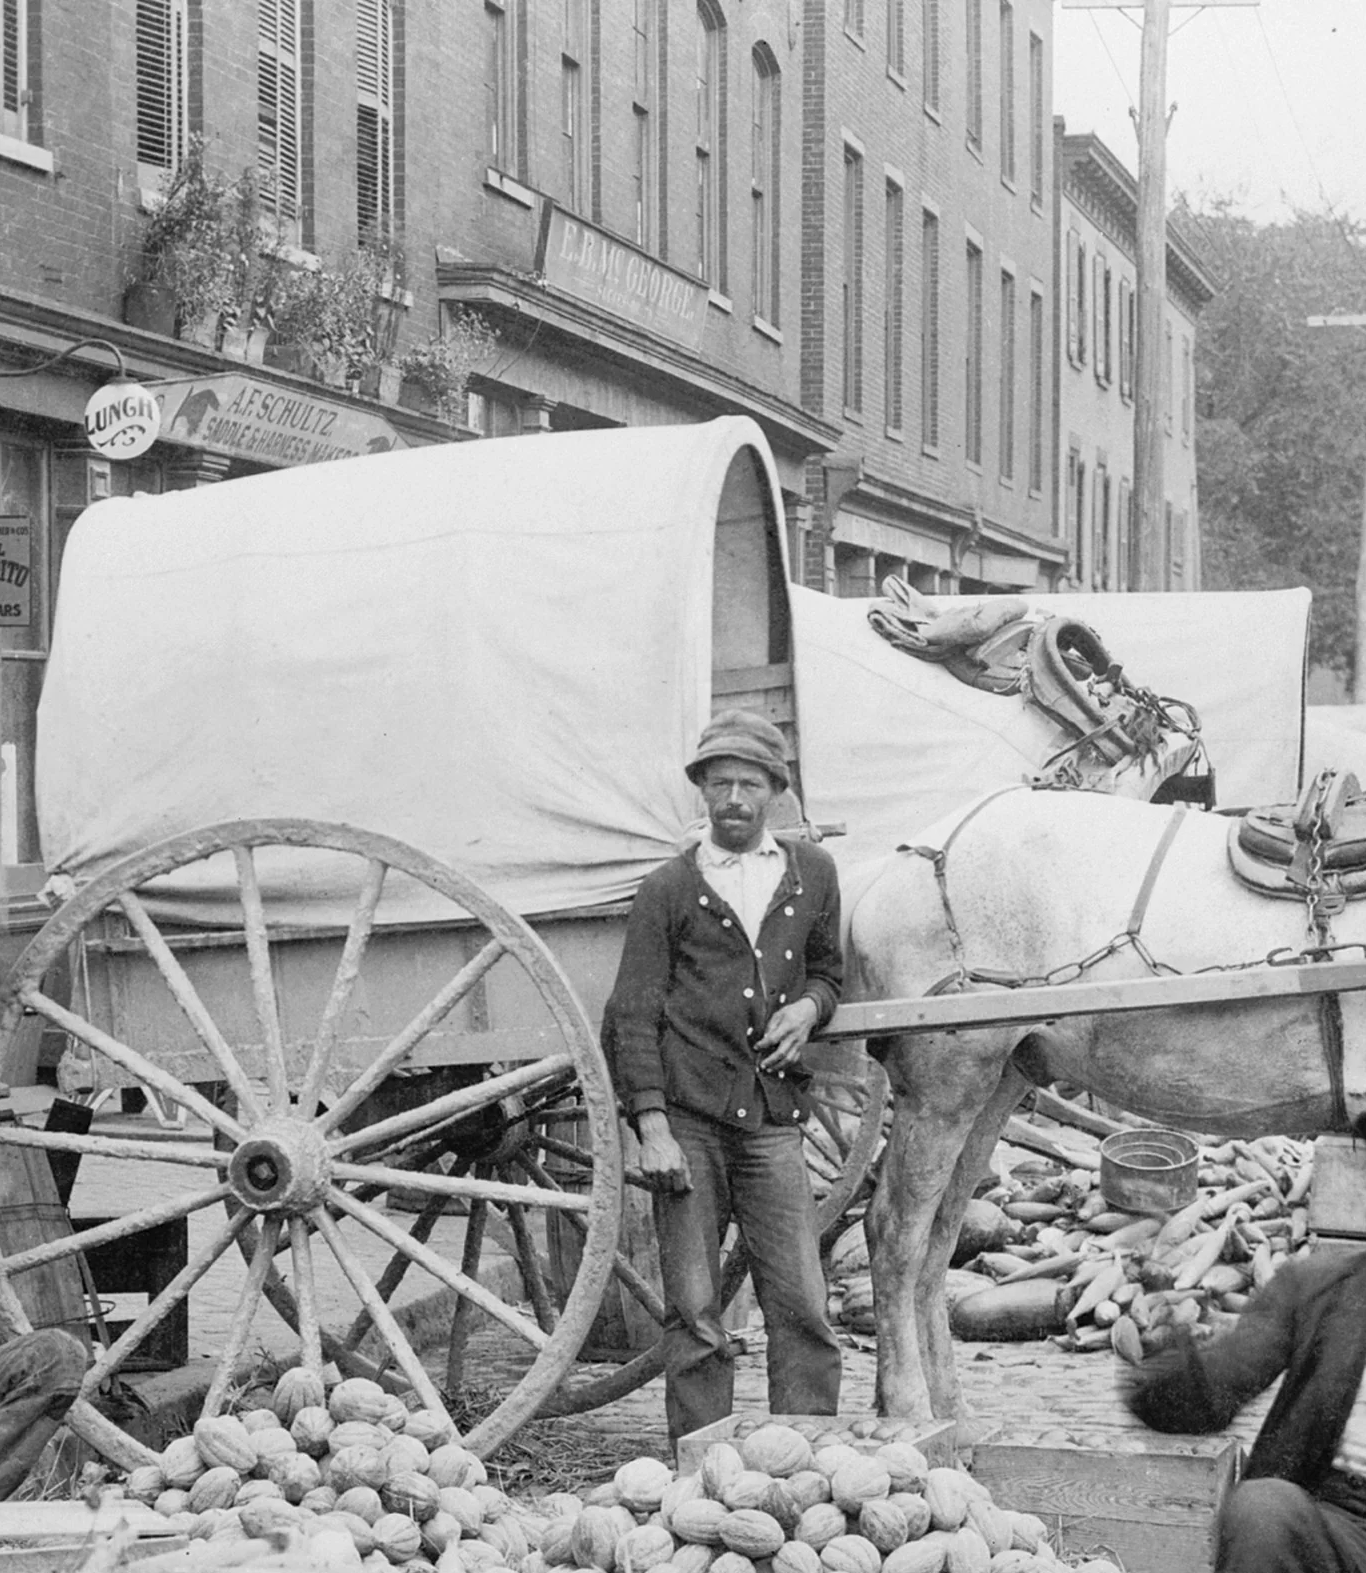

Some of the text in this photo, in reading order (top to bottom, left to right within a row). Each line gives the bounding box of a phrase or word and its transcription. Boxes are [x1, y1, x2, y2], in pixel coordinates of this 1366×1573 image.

[202, 416, 360, 463] SADDLE & HARNESS MAKE
